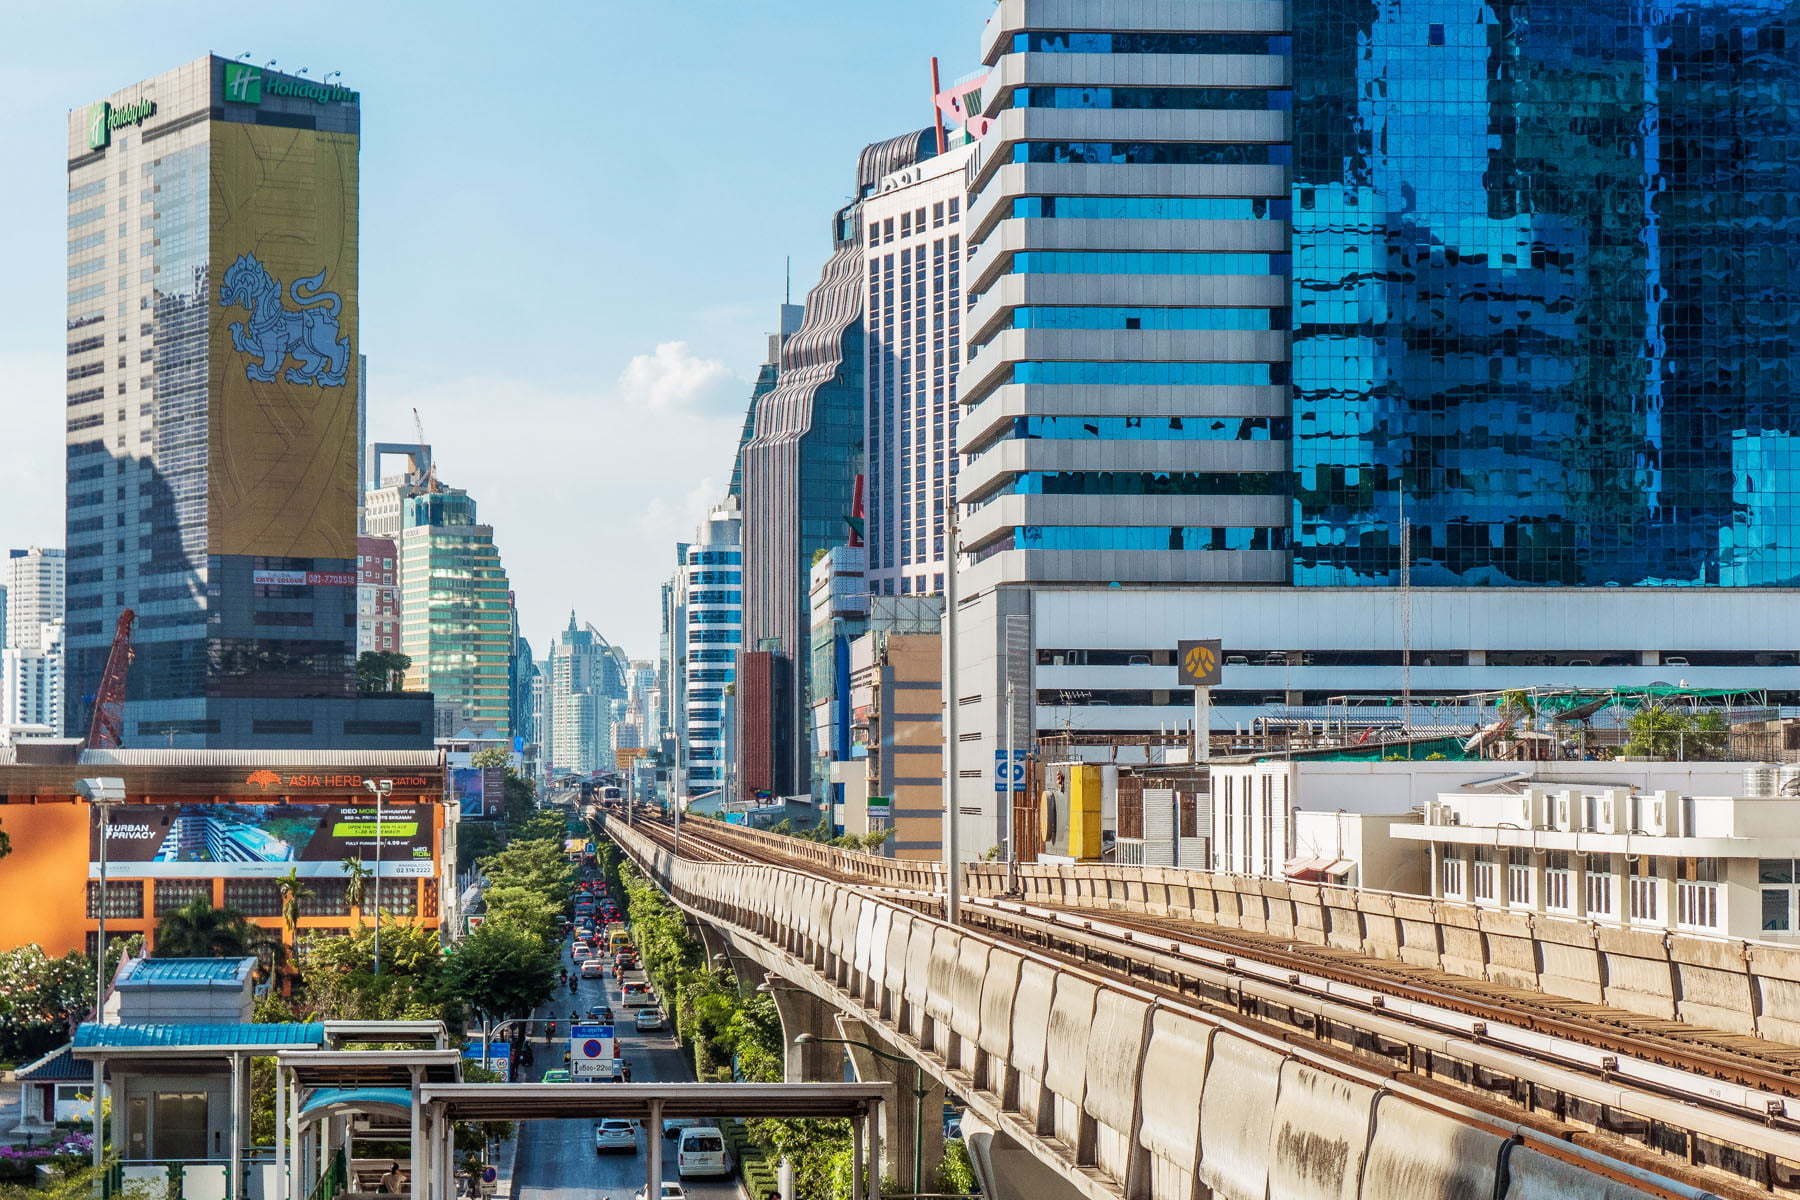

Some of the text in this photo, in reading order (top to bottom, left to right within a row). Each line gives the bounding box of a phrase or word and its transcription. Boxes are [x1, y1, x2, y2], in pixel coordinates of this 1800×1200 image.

[266, 77, 329, 103] Holiday
[108, 103, 140, 130] Holiday
[288, 775, 321, 787] ASIA
[325, 775, 362, 787] HERB
[113, 824, 149, 832] URBAN
[111, 831, 156, 840] PRIVACY
